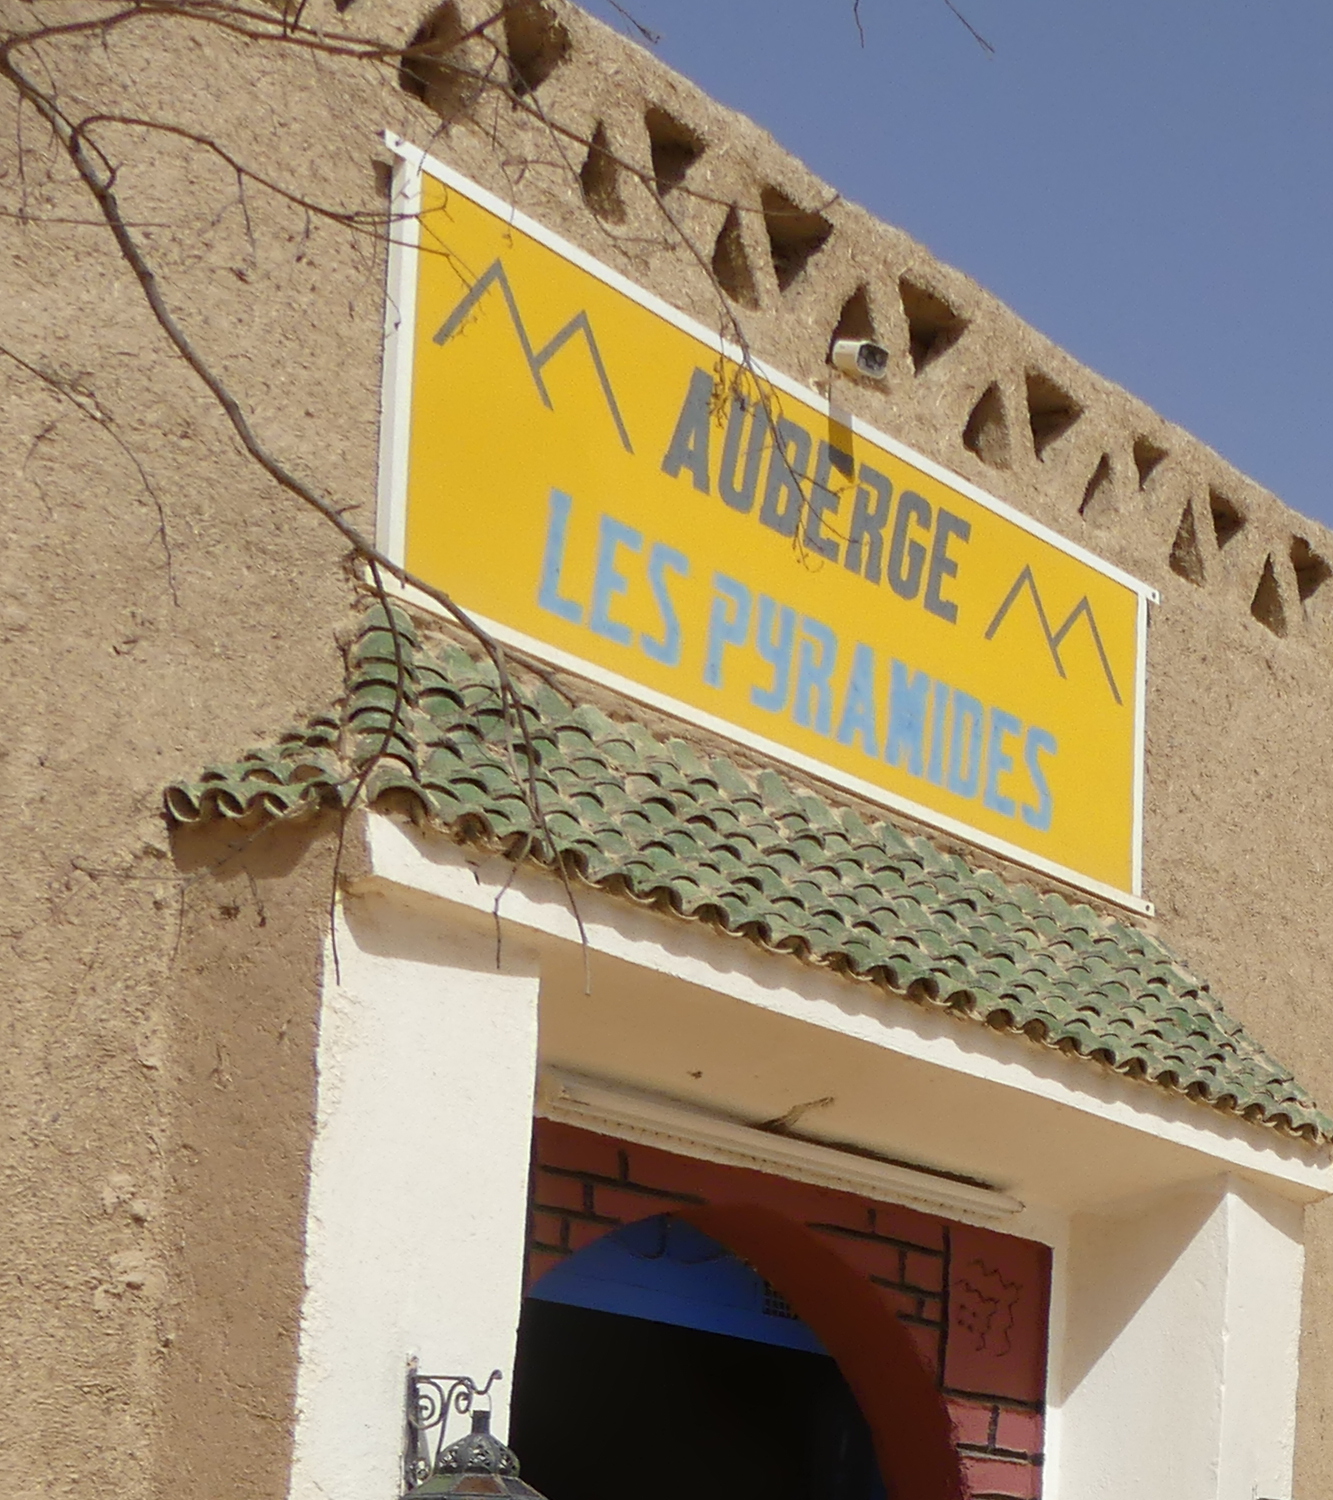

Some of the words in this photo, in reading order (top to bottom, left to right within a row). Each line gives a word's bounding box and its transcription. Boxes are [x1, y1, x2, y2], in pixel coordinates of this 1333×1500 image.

[662, 366, 971, 624] AUBERGE
[538, 488, 690, 667] LES
[704, 573, 1058, 832] PYRAMIDES
